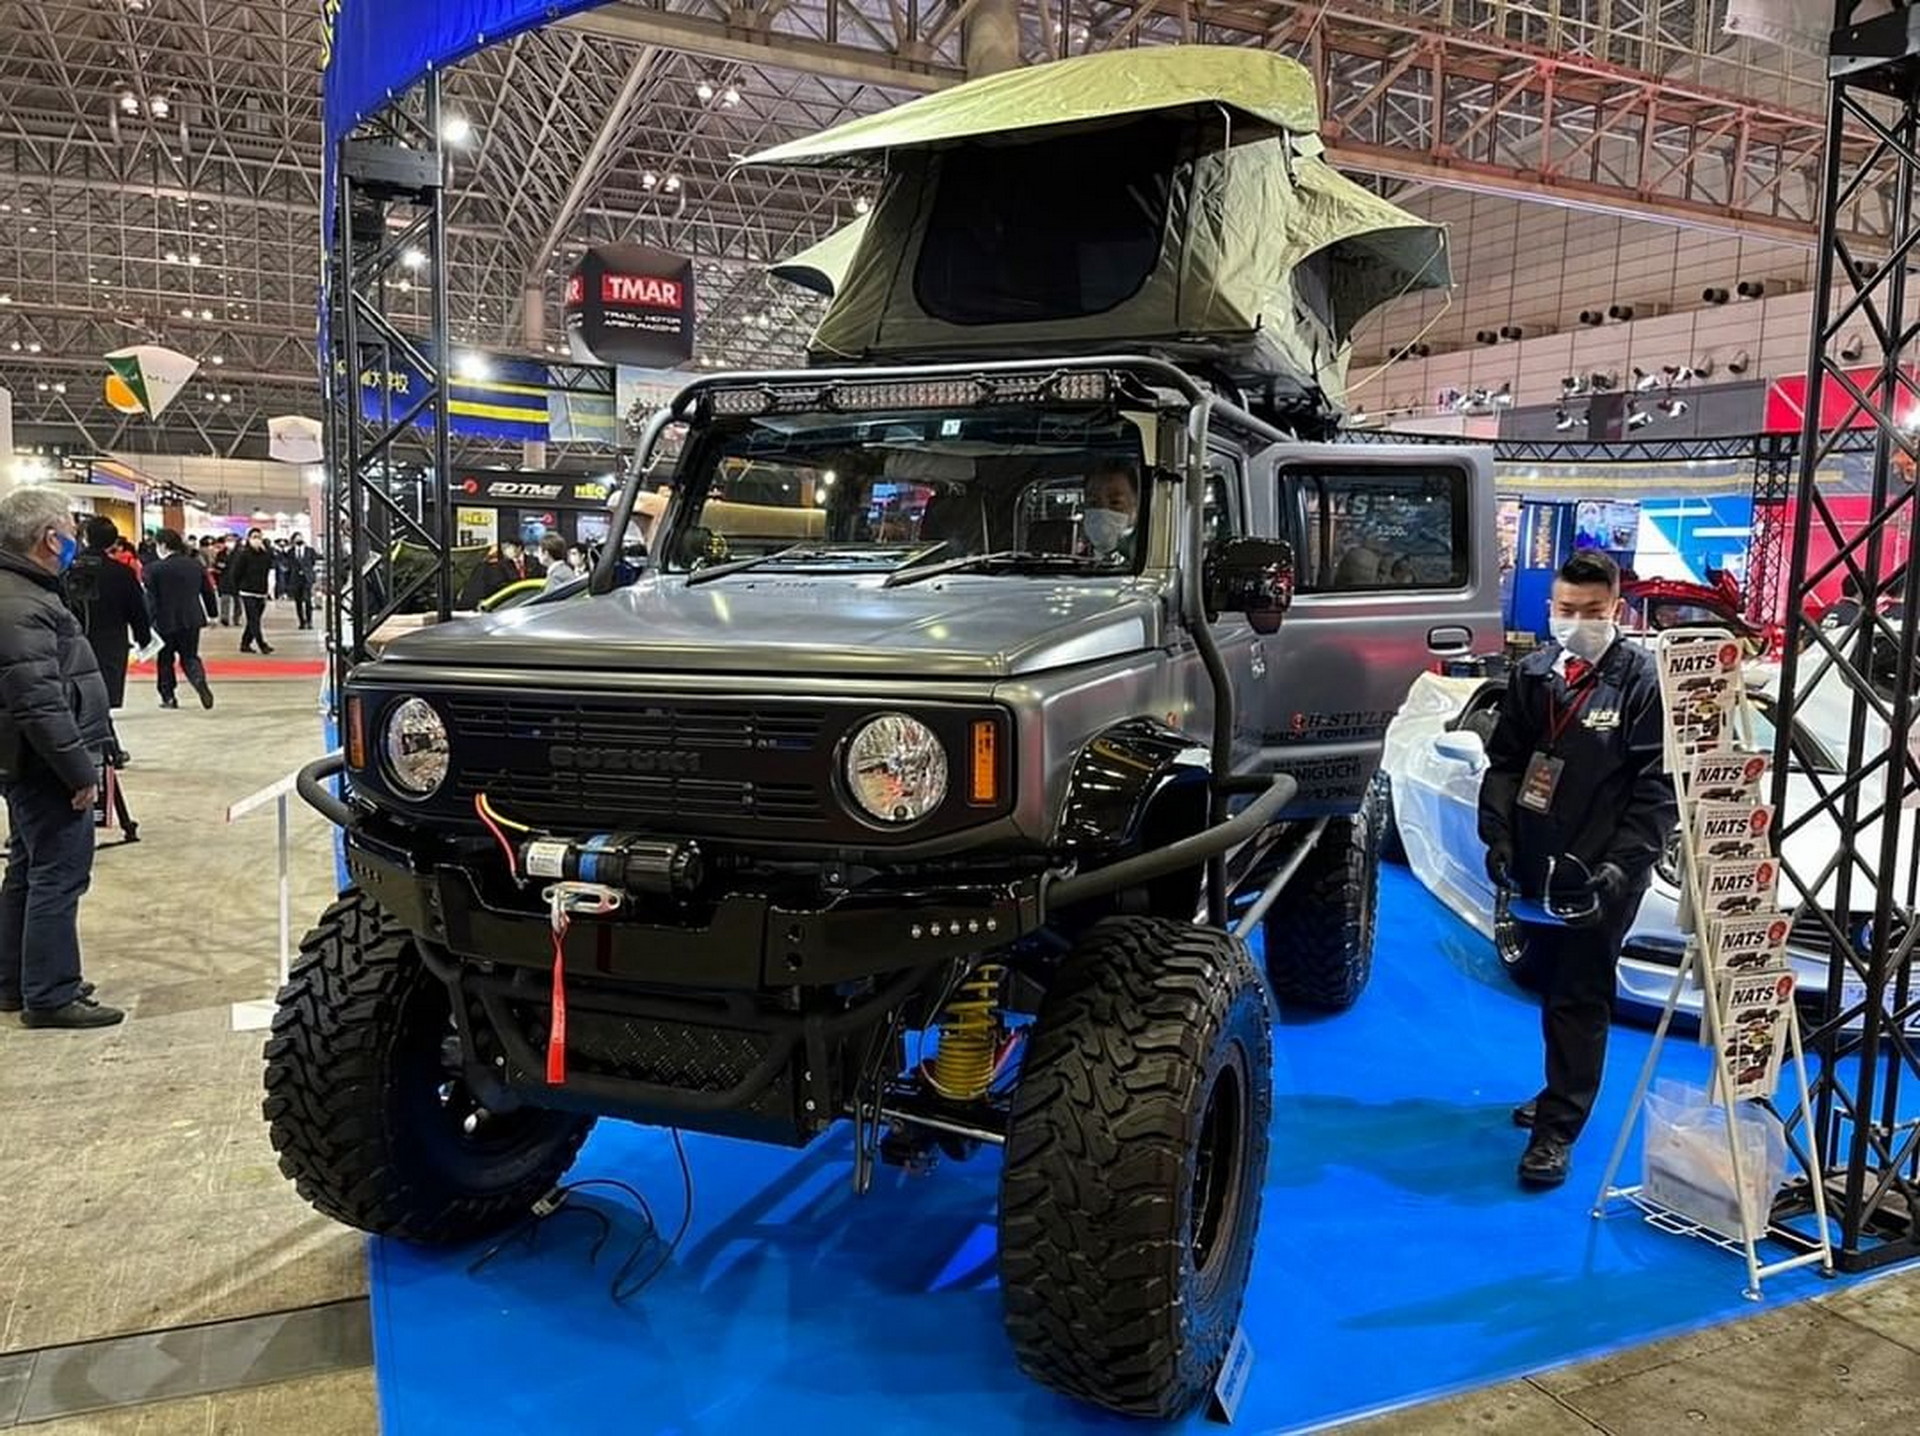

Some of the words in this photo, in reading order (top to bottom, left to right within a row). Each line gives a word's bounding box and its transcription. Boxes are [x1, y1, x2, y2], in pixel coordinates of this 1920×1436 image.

[608, 277, 677, 305] TMAR
[1669, 654, 1717, 673] NATS
[549, 746, 700, 772] SUZUKI
[1695, 766, 1743, 783] NATS
[1704, 819, 1749, 836] NATS
[1711, 873, 1755, 891] NATS
[1722, 930, 1767, 949] NATS
[1731, 985, 1776, 1005] NATS
